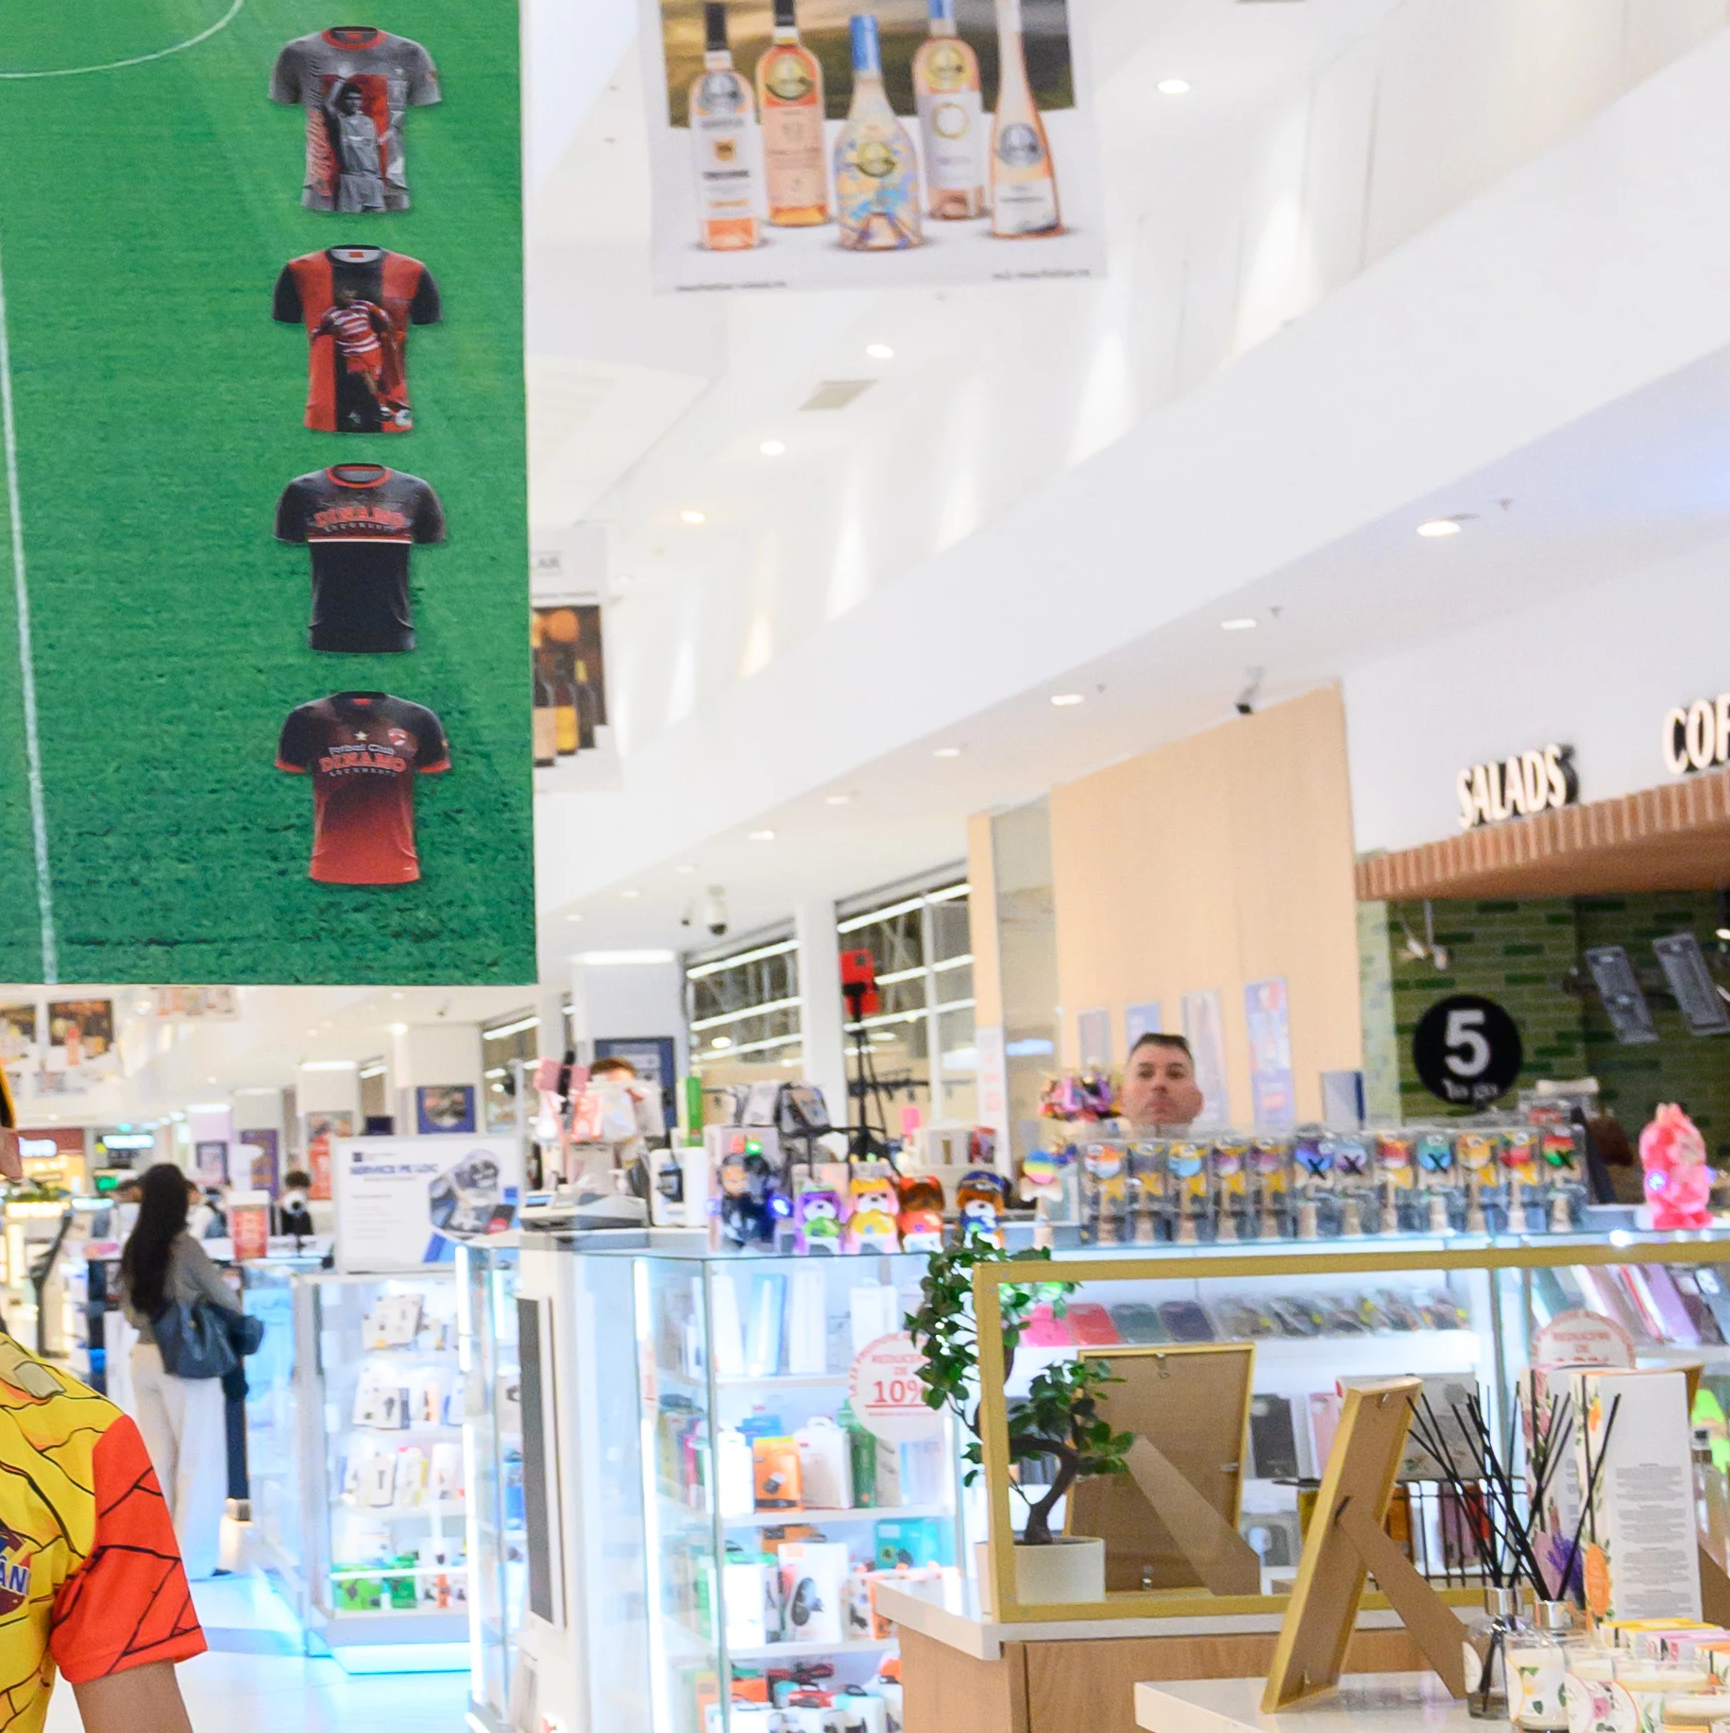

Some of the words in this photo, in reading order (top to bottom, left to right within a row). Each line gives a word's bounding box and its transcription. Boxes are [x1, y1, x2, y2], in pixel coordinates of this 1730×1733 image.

[319, 752, 407, 773] DINAMO
[1457, 742, 1572, 830] SALADS
[1444, 1008, 1491, 1077] 5
